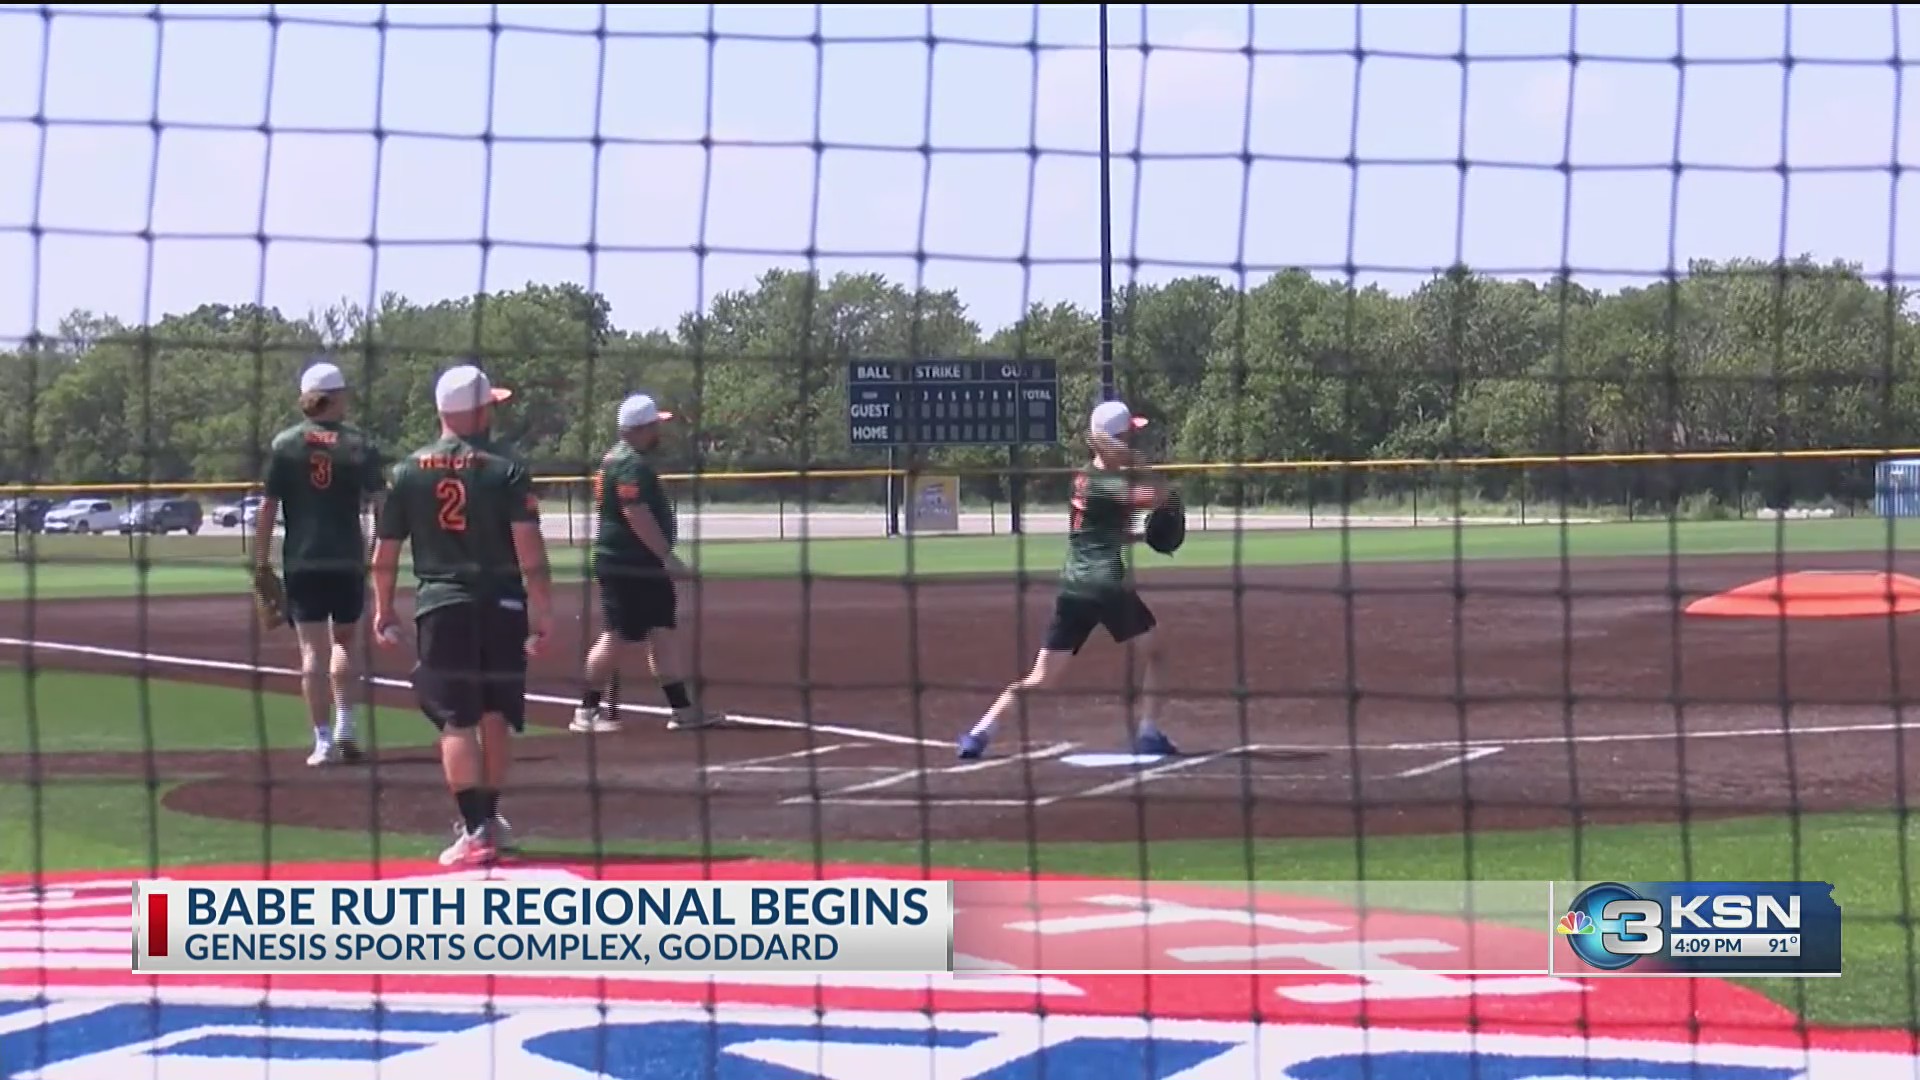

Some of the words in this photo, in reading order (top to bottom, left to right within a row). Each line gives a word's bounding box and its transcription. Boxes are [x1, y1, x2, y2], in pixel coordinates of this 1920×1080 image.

[857, 366, 890, 379] BALL
[916, 365, 960, 378] STRIKE
[1001, 365, 1028, 377] OU
[1022, 390, 1051, 400] TOTAL
[851, 404, 890, 417] GUEST
[852, 426, 888, 439] HOME
[310, 451, 332, 489] 3
[434, 477, 467, 531] 2
